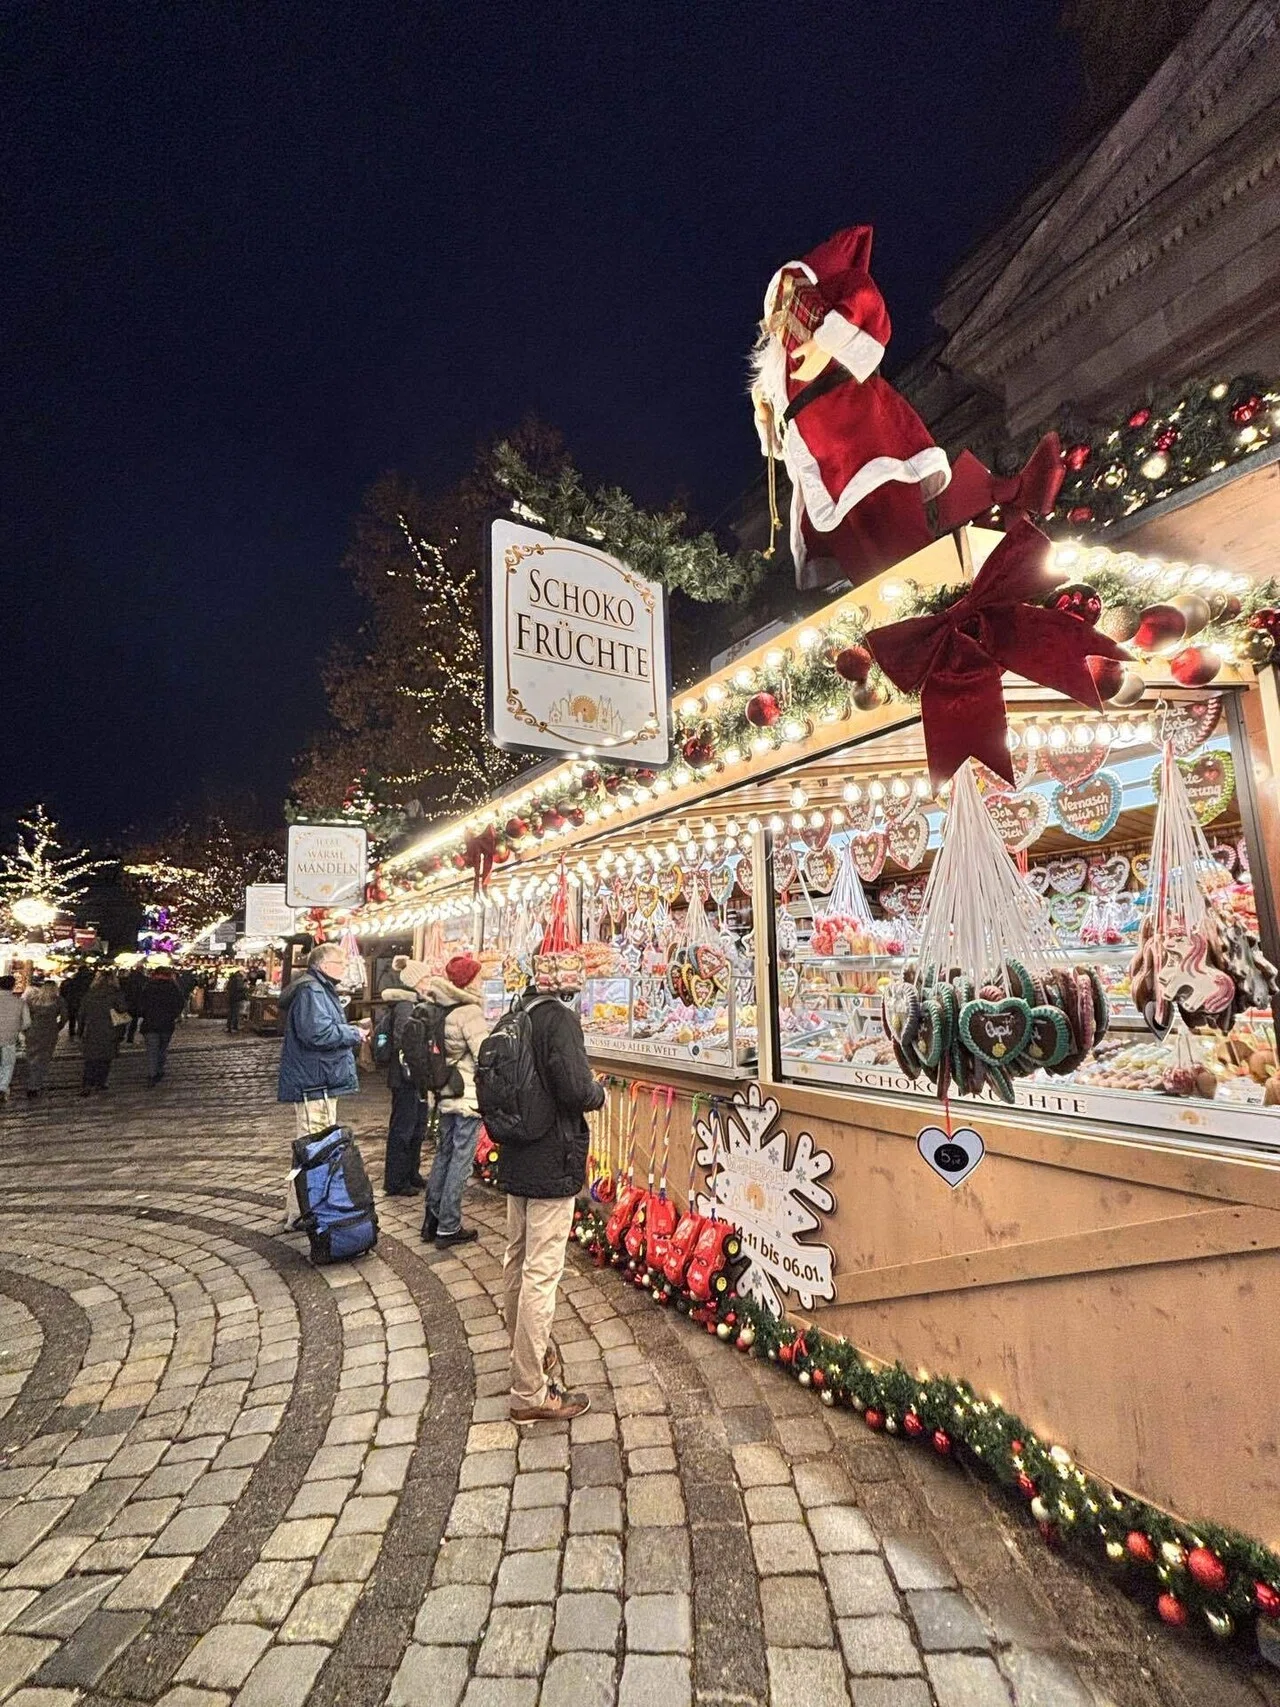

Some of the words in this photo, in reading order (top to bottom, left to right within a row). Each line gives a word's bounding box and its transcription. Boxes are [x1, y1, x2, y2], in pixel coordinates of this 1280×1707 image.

[529, 568, 635, 627] SCHOKO
[516, 612, 649, 677] FRÜCHTE
[1058, 792, 1109, 812] Vernasch
[297, 862, 358, 874] MANDELN
[628, 1042, 652, 1053] ALLER
[652, 1044, 678, 1057] WELT
[760, 1236, 780, 1266] bis
[782, 1256, 825, 1283] 06.01.
